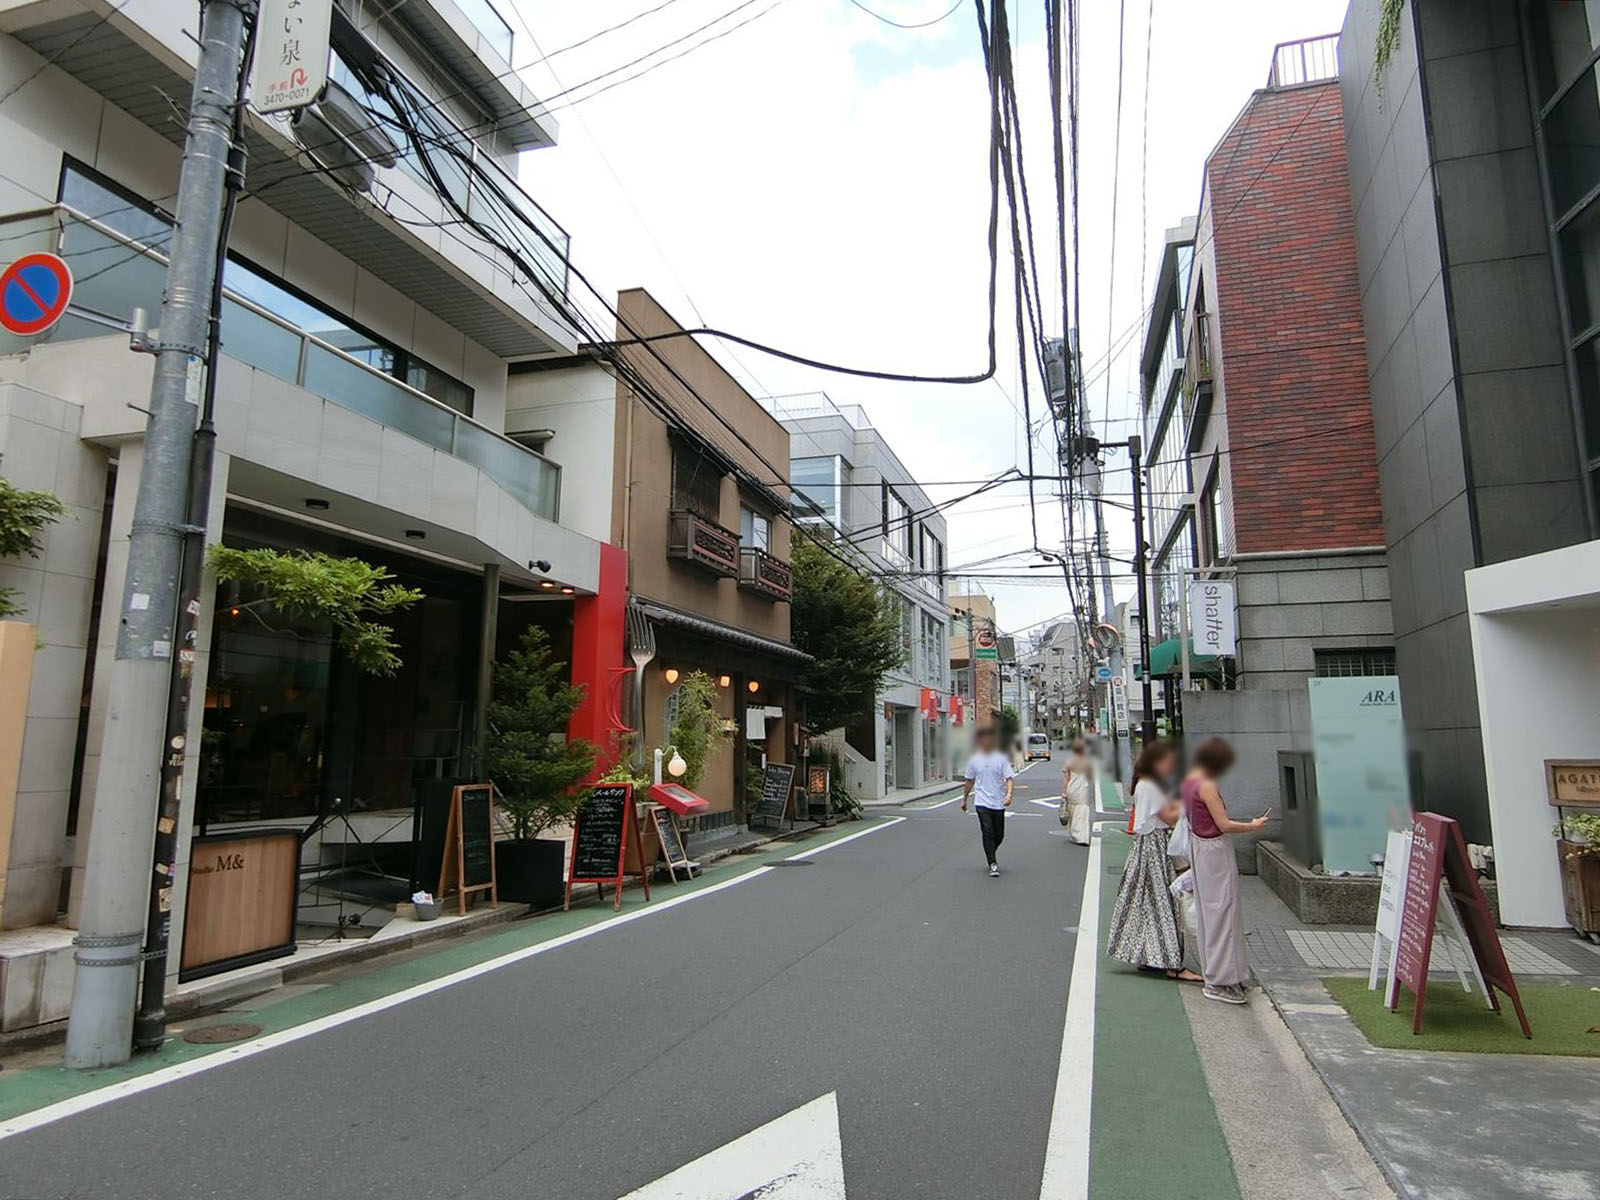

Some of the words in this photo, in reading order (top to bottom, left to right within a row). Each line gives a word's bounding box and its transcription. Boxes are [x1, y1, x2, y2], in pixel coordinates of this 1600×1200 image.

[264, 88, 309, 105] 3470-0071
[1204, 585, 1223, 650] shatter
[1361, 689, 1396, 703] ARA
[1558, 773, 1600, 785] AGAT
[215, 853, 245, 872] M&
